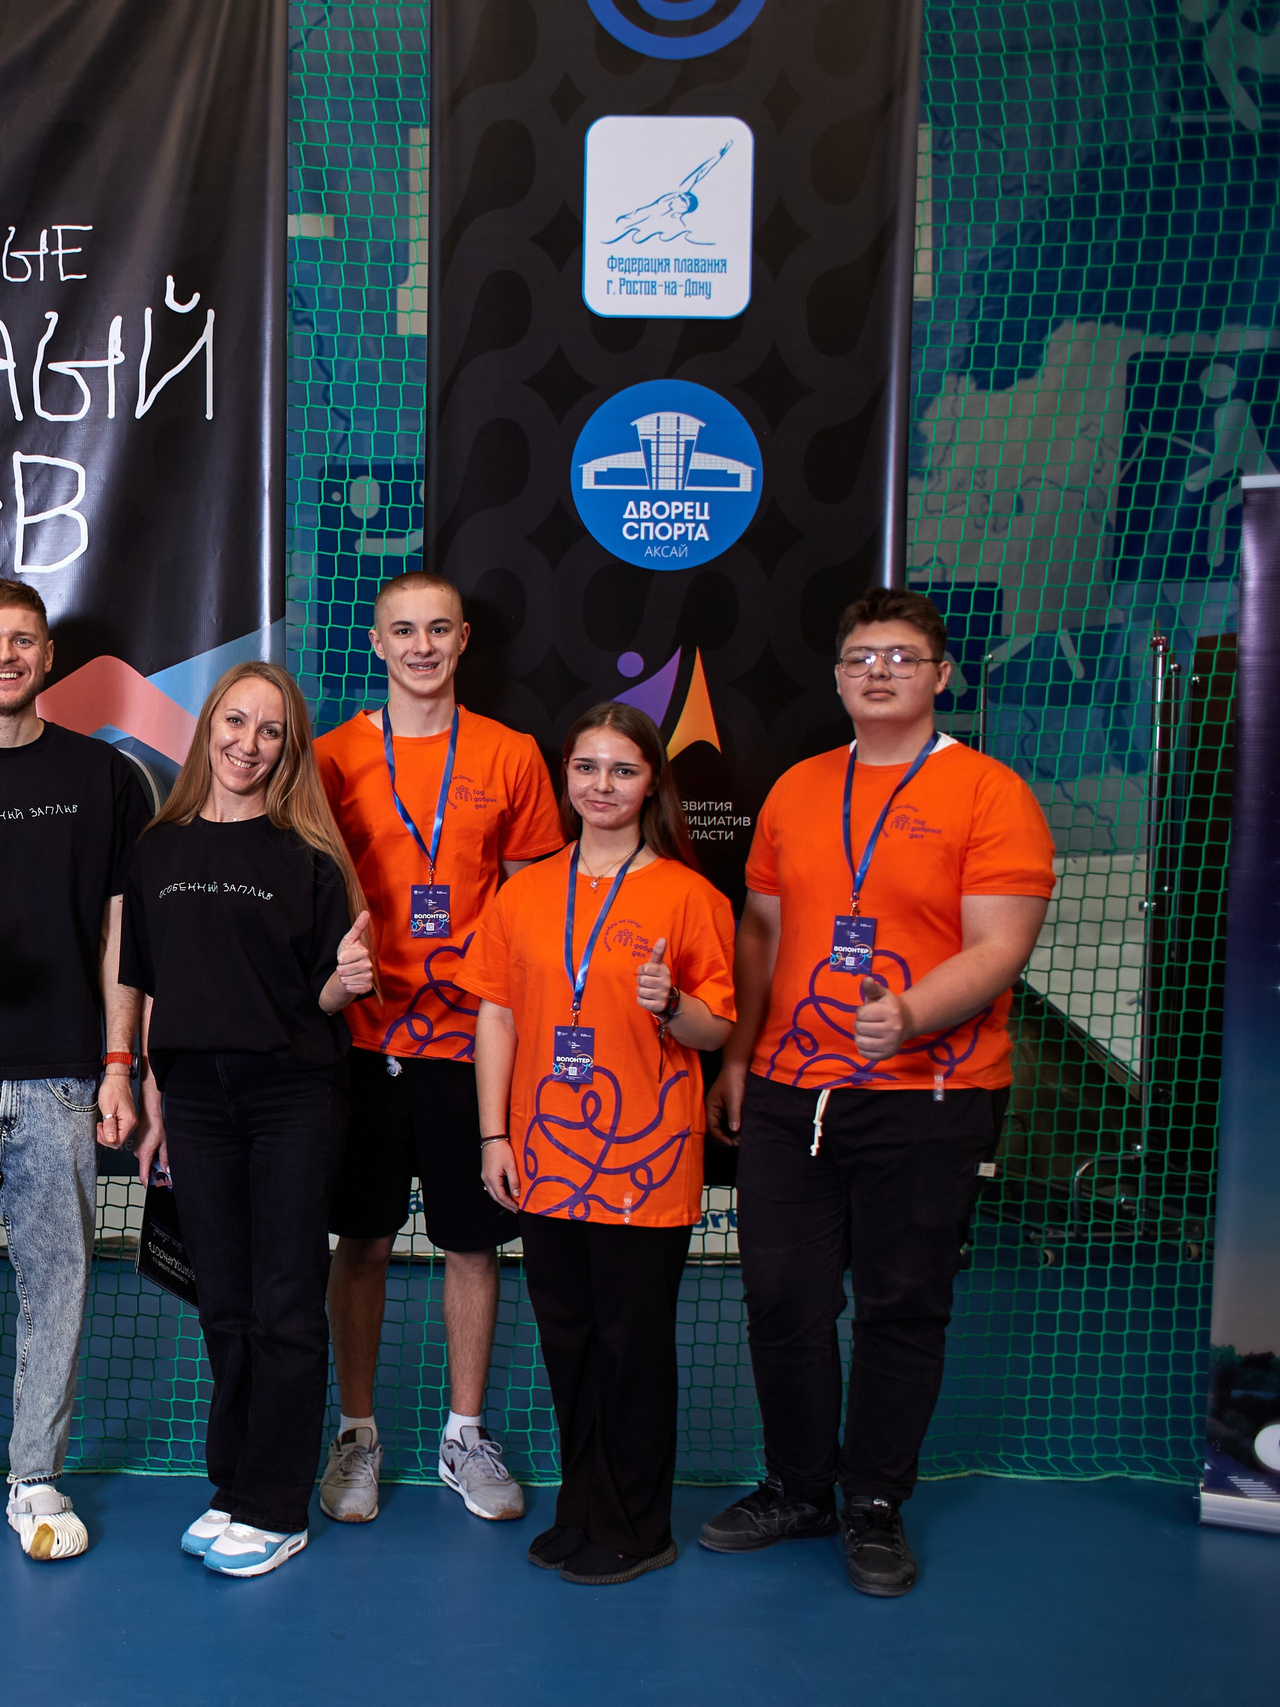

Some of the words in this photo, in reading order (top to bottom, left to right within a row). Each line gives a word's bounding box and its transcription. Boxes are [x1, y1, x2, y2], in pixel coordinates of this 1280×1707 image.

[607, 255, 670, 276] Федерация
[674, 258, 727, 274] плавания
[606, 280, 616, 295] г.
[619, 277, 712, 300] Ростов-на-Дону
[623, 500, 710, 520] ДВОРЕЦ
[622, 521, 710, 541] СПОРТА
[644, 543, 688, 558] АКСАЙ
[681, 800, 733, 812] ЗВИТИЯ
[685, 815, 751, 827] ИЦИАТИВ
[688, 829, 734, 840] ЛАСТИ
[633, 944, 653, 953] добр
